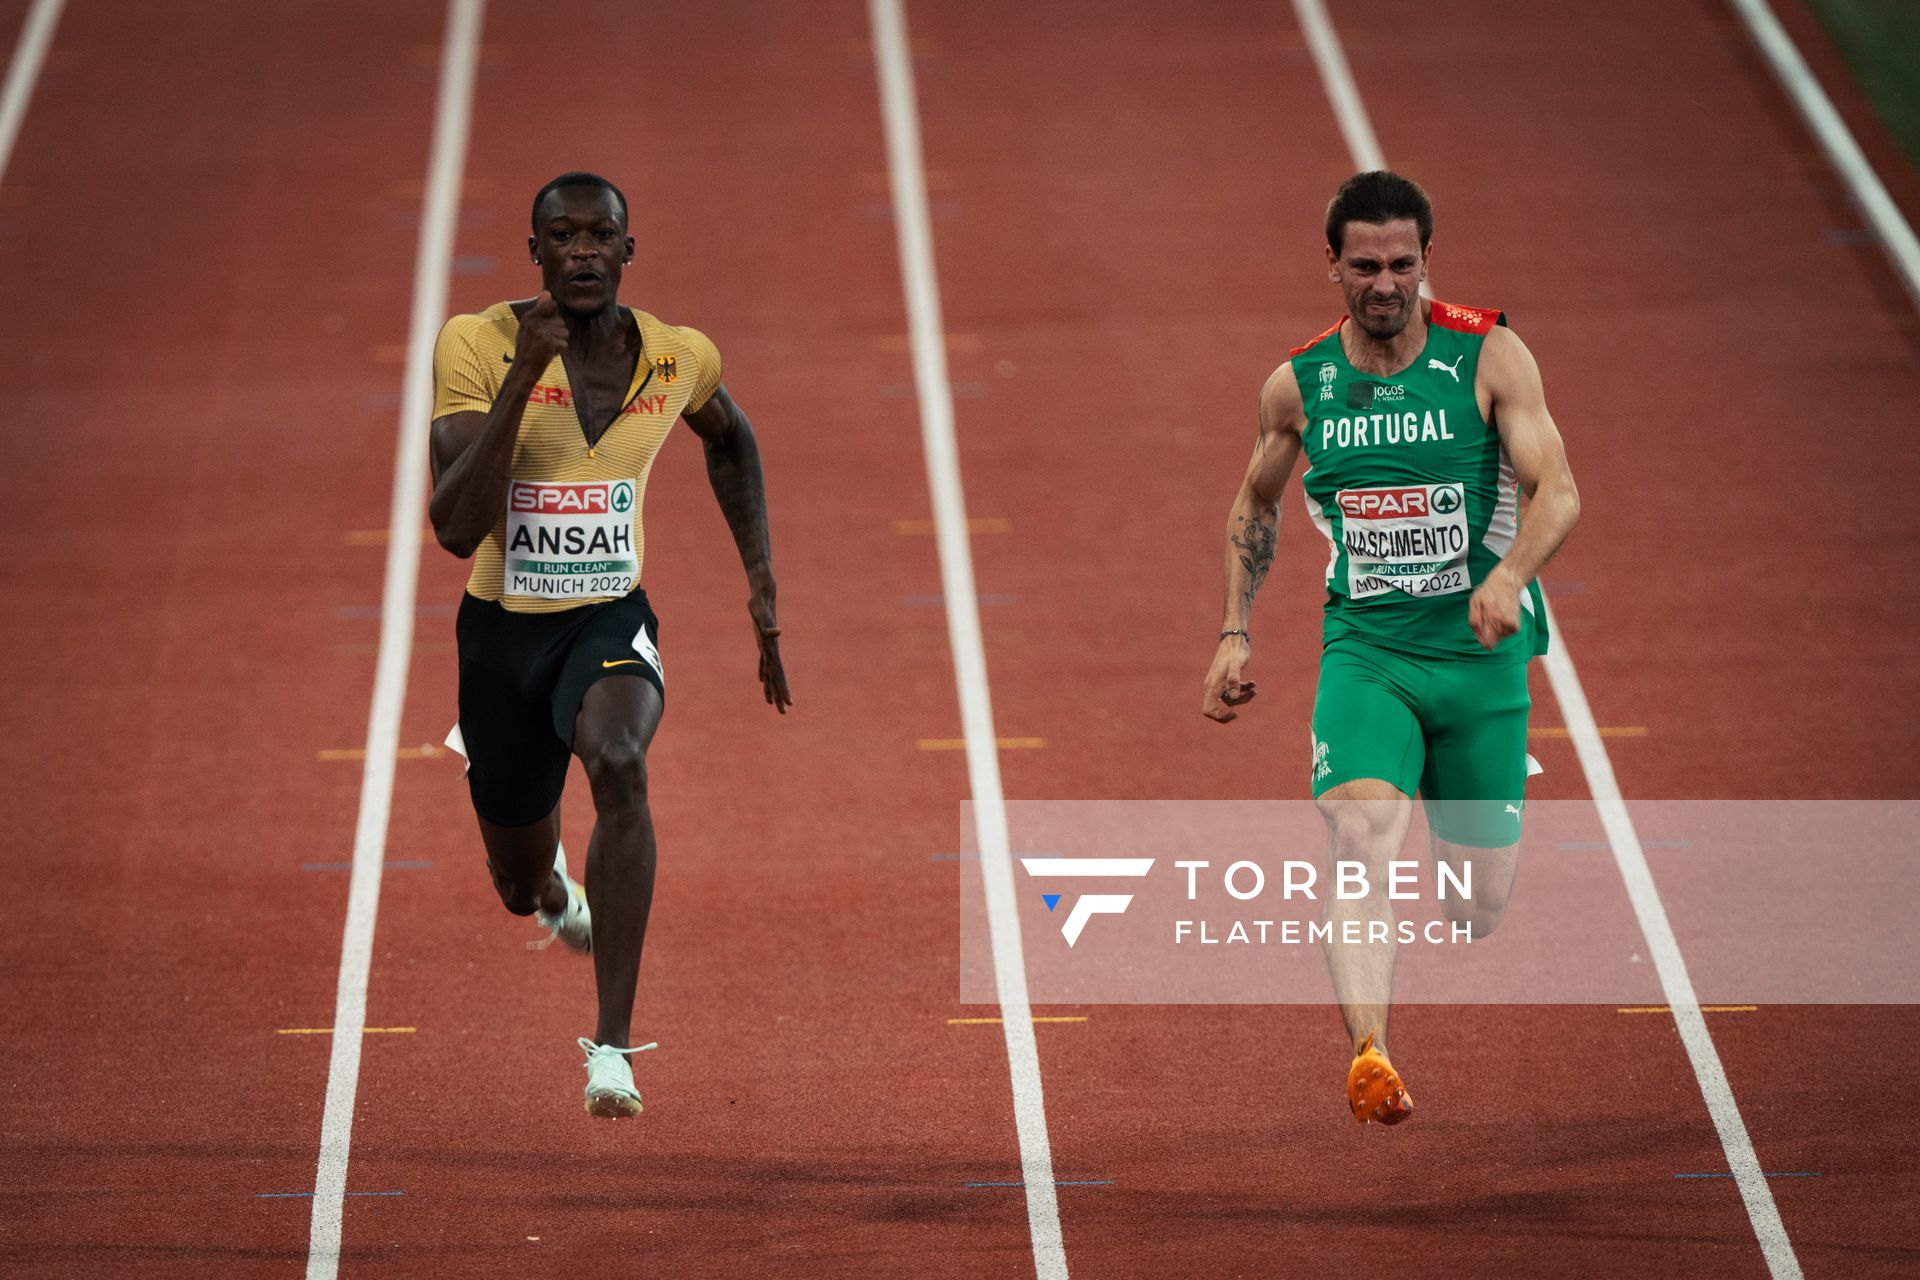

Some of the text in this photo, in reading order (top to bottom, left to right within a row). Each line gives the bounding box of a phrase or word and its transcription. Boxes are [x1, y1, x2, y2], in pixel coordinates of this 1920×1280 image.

[1320, 391, 1334, 401] FPA
[1374, 385, 1405, 400] JOGOS
[1322, 409, 1454, 449] PORTUGAL
[514, 487, 606, 510] SPAR
[1339, 492, 1426, 515] SPAR
[510, 524, 630, 555] ANSAH
[1346, 524, 1464, 559] NASCIMENTO
[544, 563, 569, 573] RUN
[1376, 564, 1393, 574] RUN
[513, 575, 632, 593] MUNICH 2022
[1420, 571, 1462, 593] 2022
